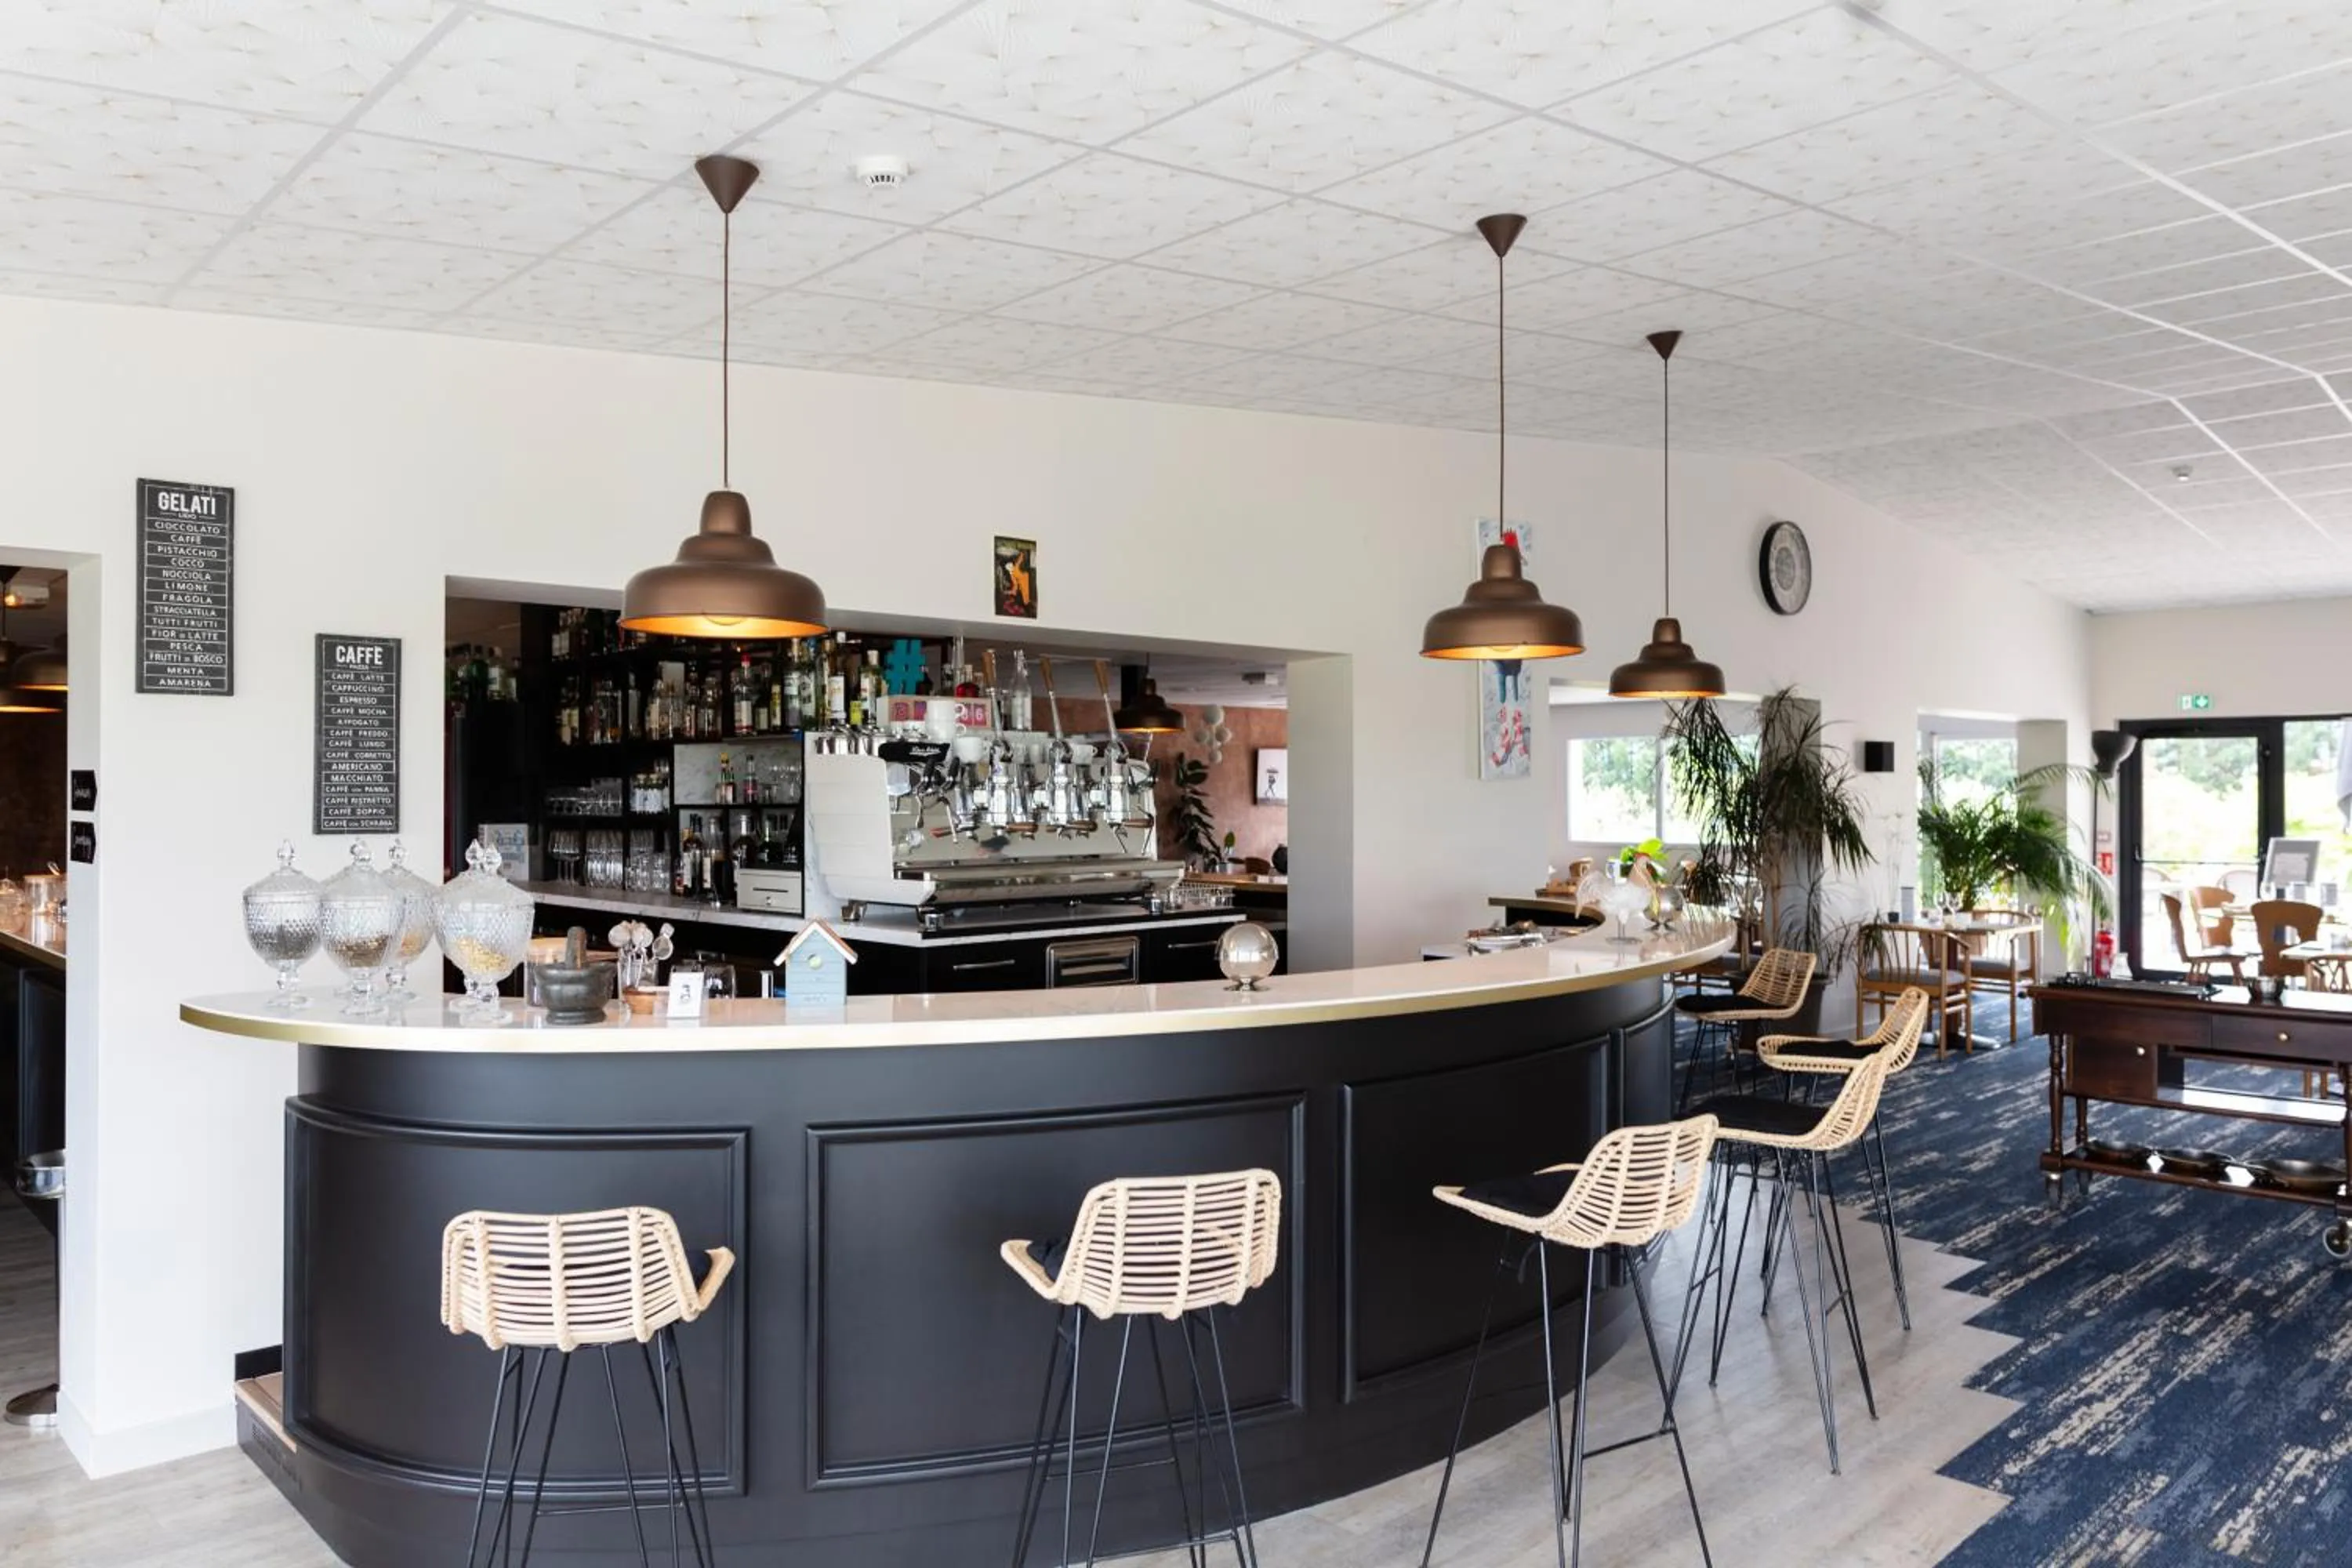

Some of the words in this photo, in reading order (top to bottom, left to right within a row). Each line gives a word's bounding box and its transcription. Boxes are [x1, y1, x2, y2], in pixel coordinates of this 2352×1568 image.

[158, 492, 216, 515] GELATI
[154, 521, 220, 534] CIOCCOLATO
[158, 545, 217, 557] PISTACCHIO
[171, 557, 205, 568] COCCO
[162, 569, 212, 581] NOCCIOLA
[165, 582, 208, 592] LIMONE
[162, 593, 212, 604] FRAGOLA
[153, 605, 217, 616] STRACCIATELLA
[152, 617, 180, 626] TUTTI
[184, 619, 217, 628] FRUTTI
[151, 630, 176, 639] FIOR
[188, 631, 219, 641] LATTE
[170, 642, 203, 652] PESCA
[150, 652, 182, 662] FRUTTI
[194, 654, 223, 664] BOSCO
[167, 666, 205, 675] MENTA
[159, 678, 212, 688] AMARENA
[361, 673, 385, 683] LATTE
[332, 684, 385, 693] CAPPUCCINO
[339, 695, 377, 705] ESPRESSO
[358, 707, 387, 716] MOCHA
[337, 718, 379, 727] AFFOGATO
[358, 729, 388, 738] FREDDO
[330, 774, 383, 782] MACCHIATO
